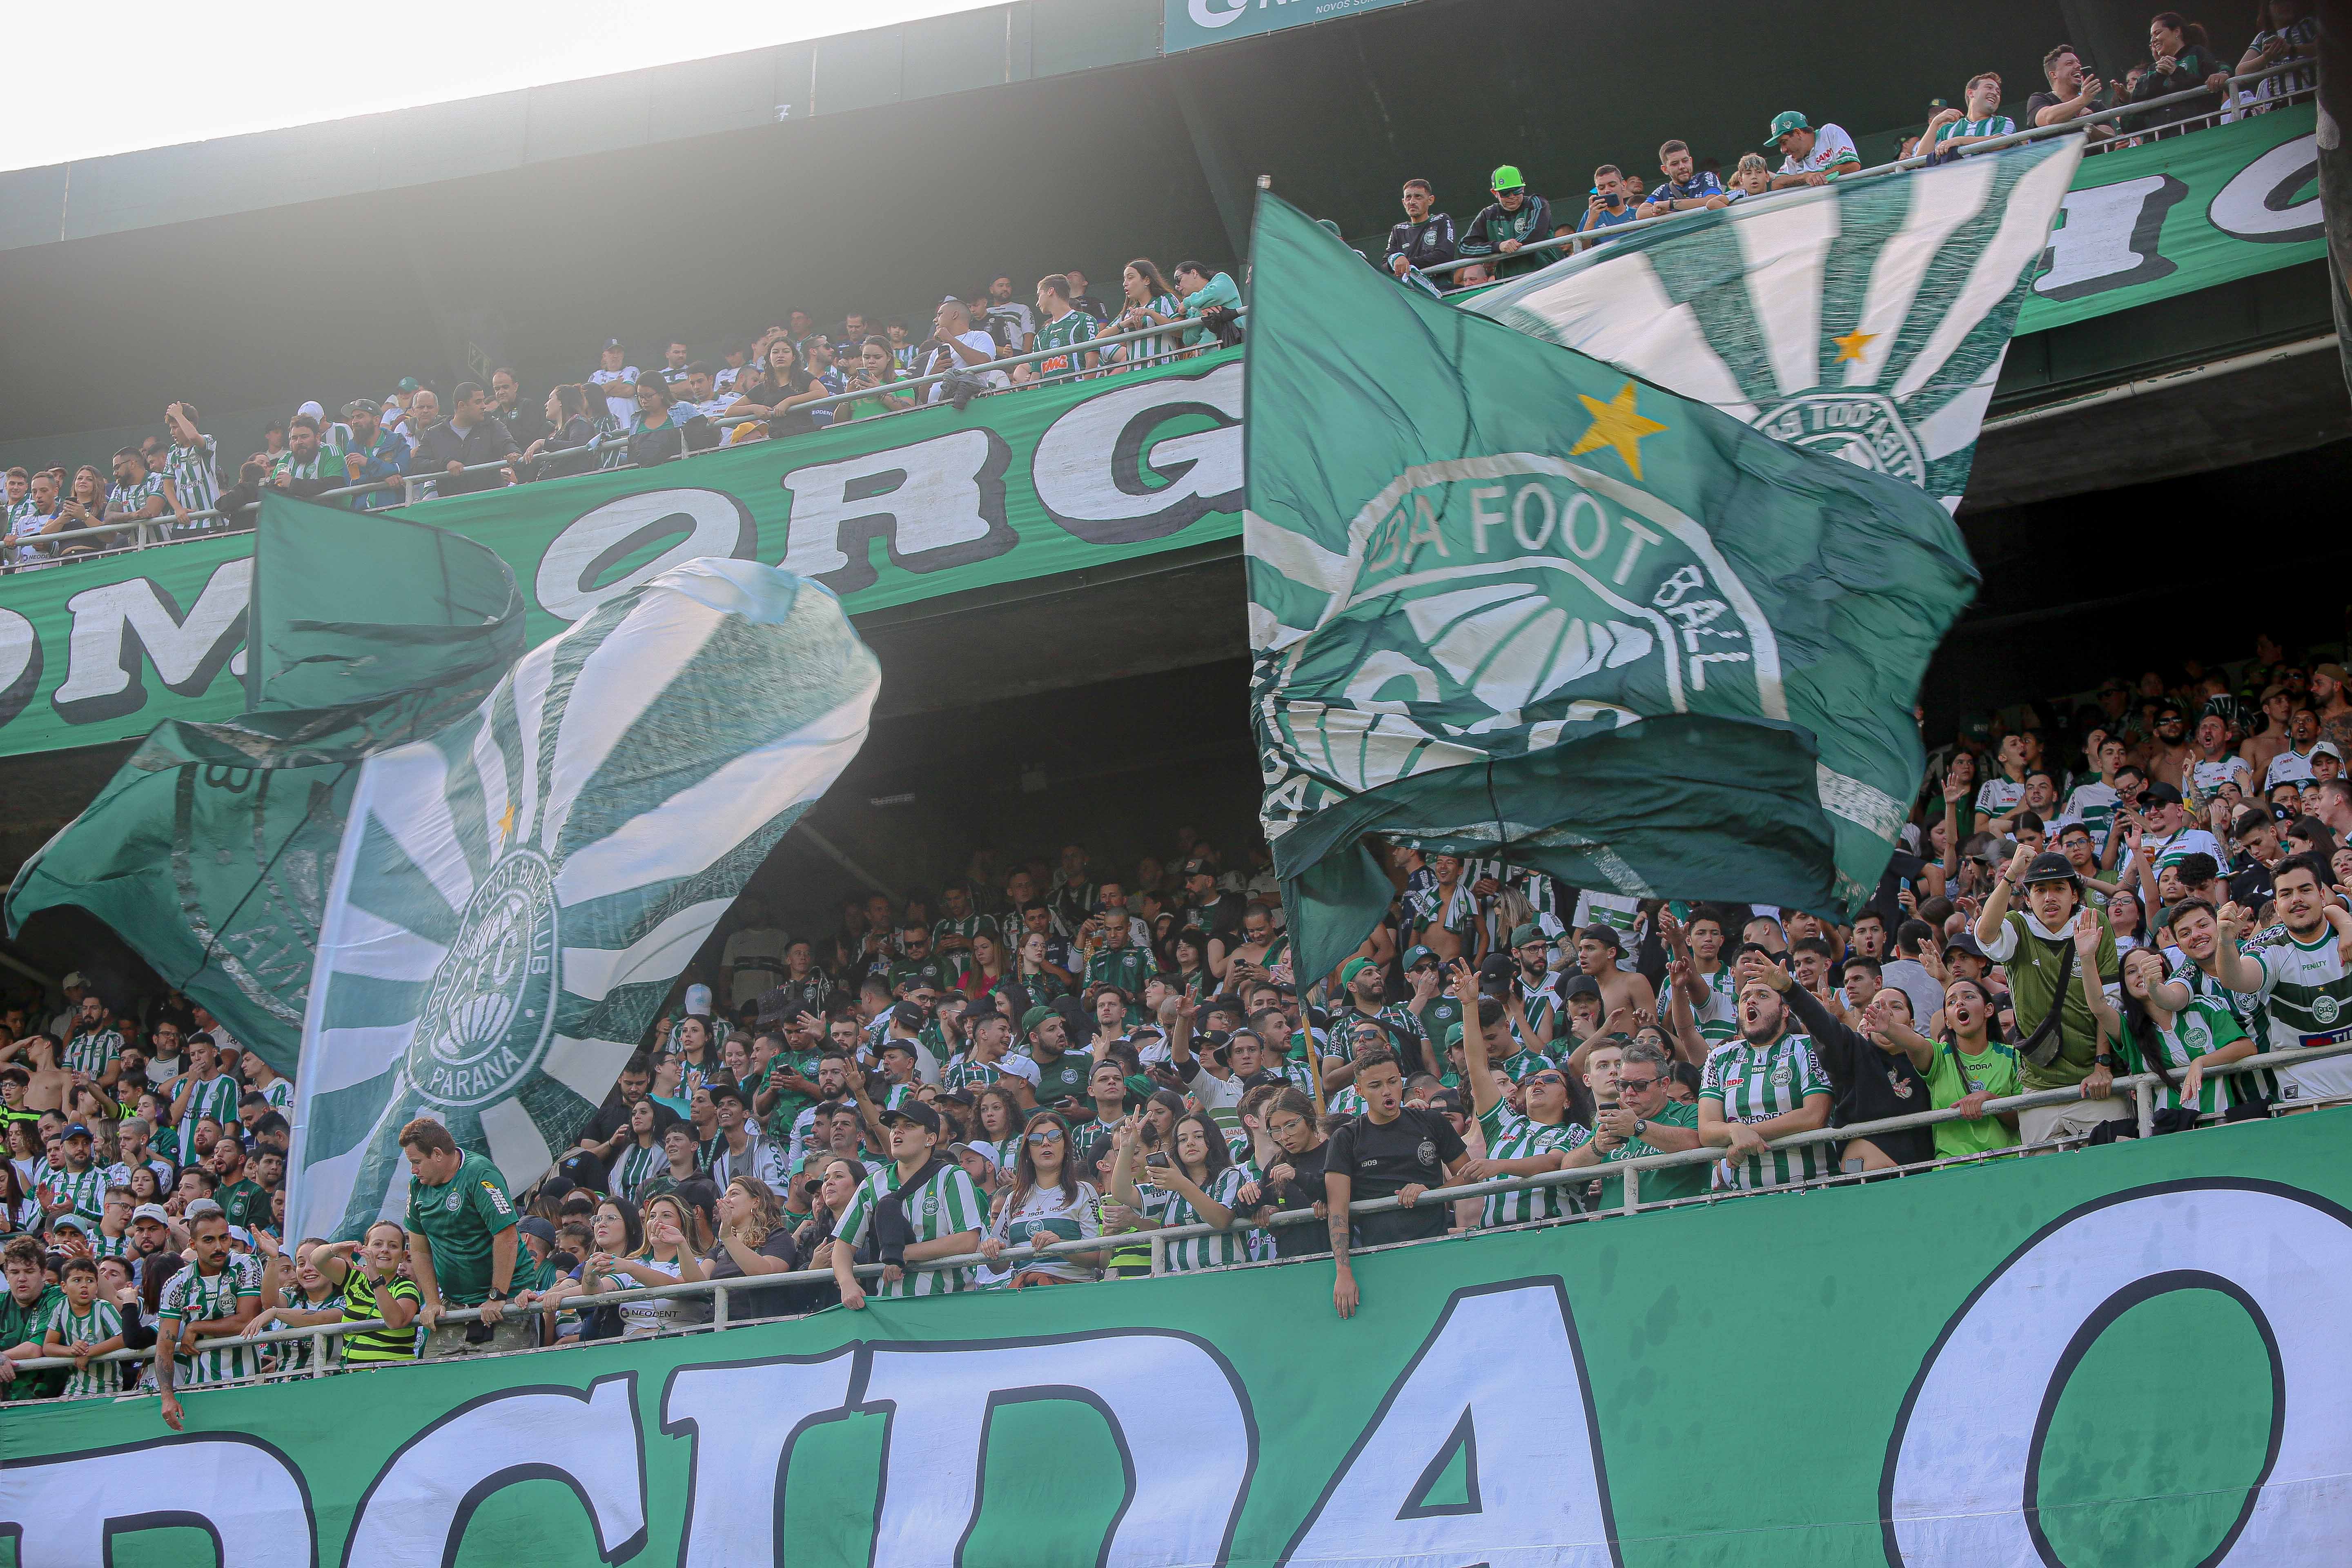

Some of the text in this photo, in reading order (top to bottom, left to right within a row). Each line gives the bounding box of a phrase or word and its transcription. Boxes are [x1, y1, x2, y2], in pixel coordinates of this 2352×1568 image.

[1315, 1, 1350, 14] NOVOS
[1470, 483, 1664, 586] FOOT
[1652, 564, 1751, 691] BALL
[2318, 1005, 2333, 1013] CFC
[2190, 1033, 2202, 1041] CFC
[1726, 1078, 1744, 1087] RDP
[631, 1309, 679, 1318] NEODENT
